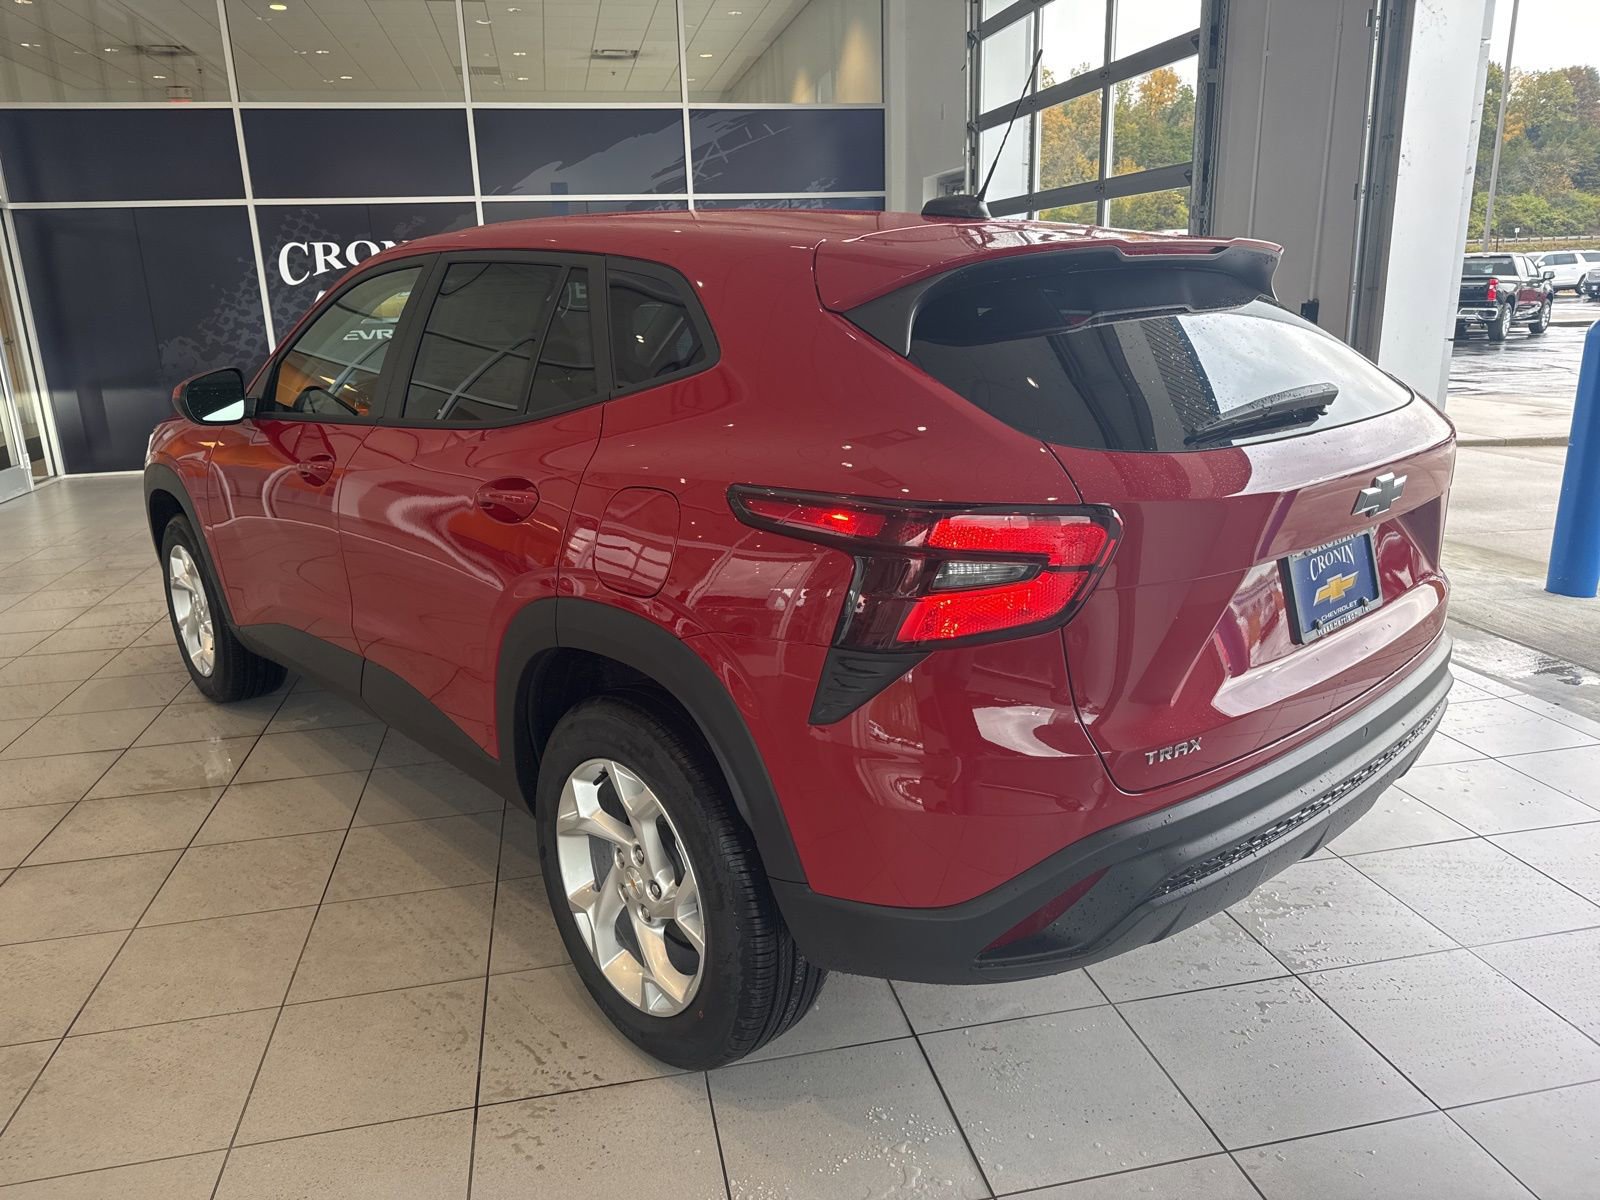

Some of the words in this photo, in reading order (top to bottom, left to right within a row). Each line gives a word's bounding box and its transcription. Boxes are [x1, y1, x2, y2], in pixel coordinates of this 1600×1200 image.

[1310, 543, 1355, 581] CRONIN
[1321, 600, 1358, 621] CHEVROLET
[1145, 736, 1202, 765] TRAX
